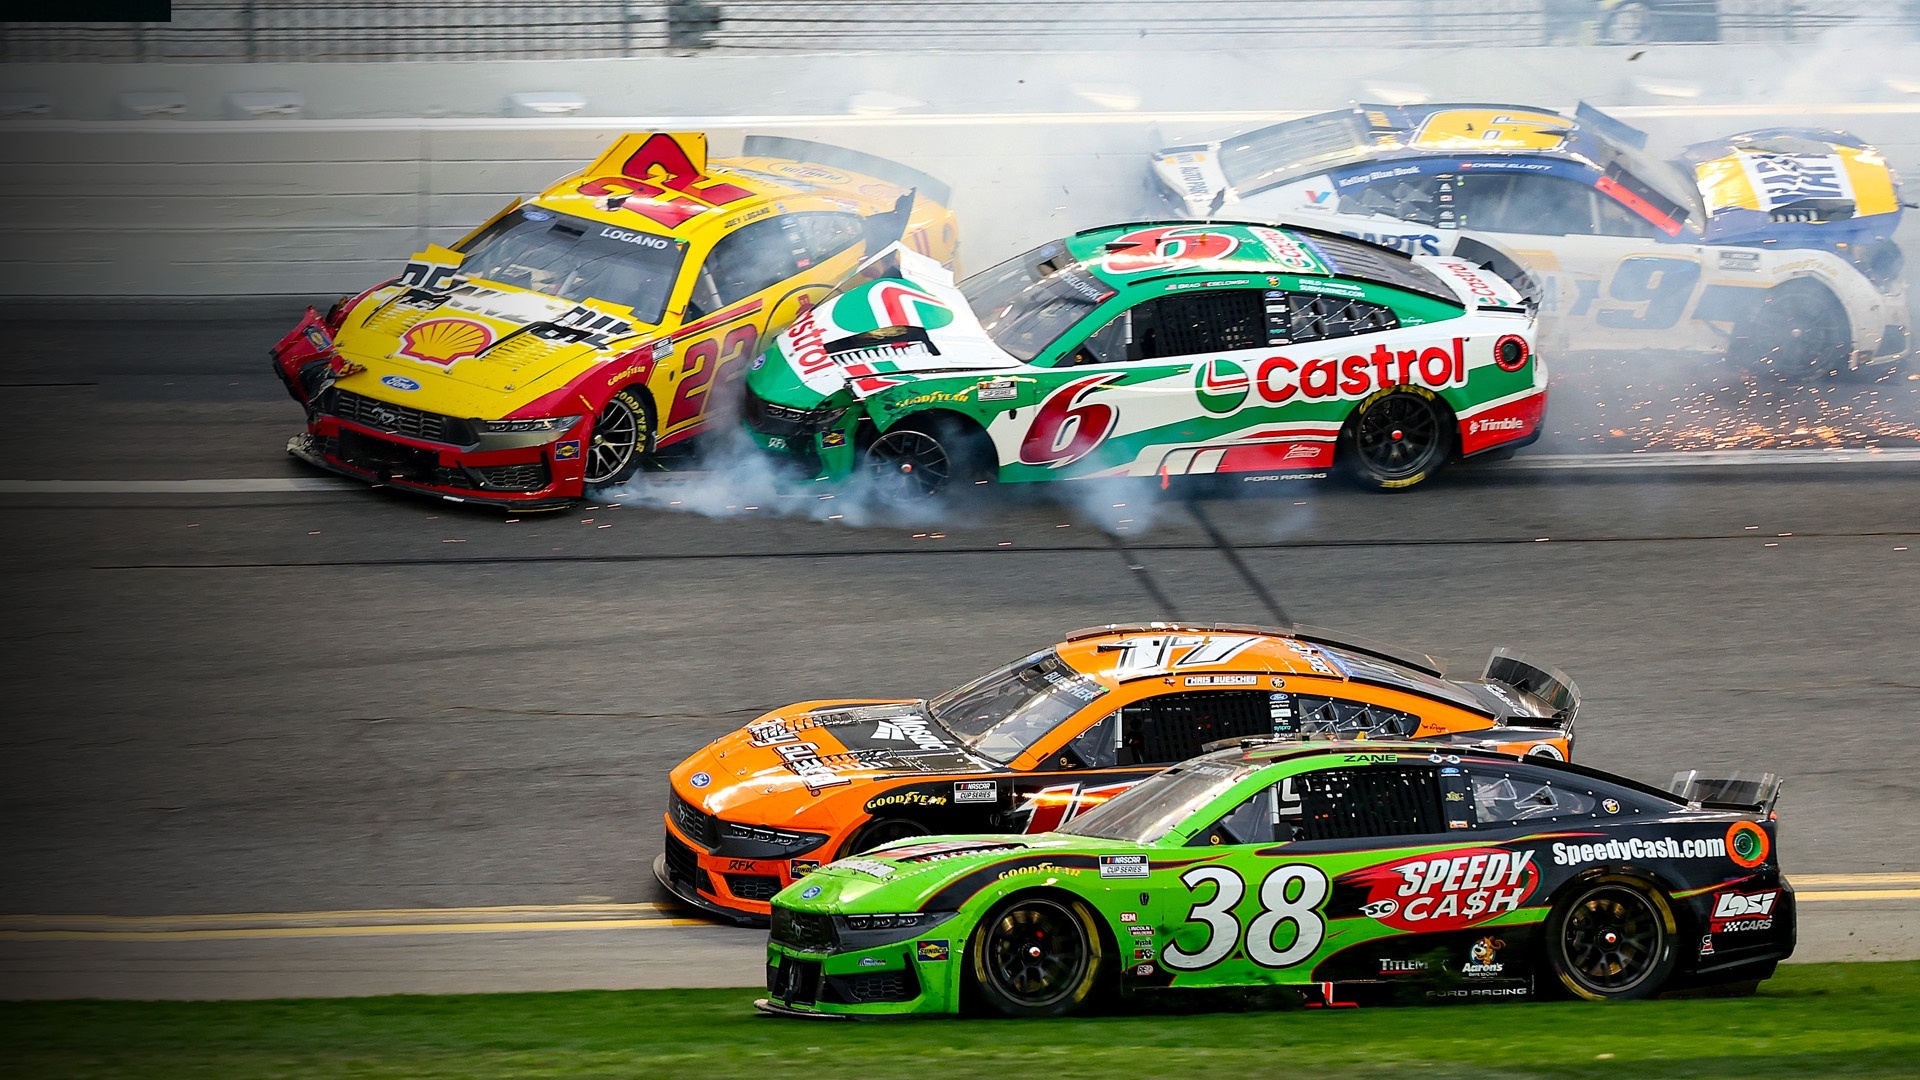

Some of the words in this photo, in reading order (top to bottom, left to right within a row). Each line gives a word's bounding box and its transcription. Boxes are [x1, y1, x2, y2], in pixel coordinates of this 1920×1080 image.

[1471, 162, 1506, 171] CHASE
[1508, 163, 1552, 171] ELLIOTT
[1338, 174, 1371, 188] Kelley
[1371, 169, 1394, 181] Blue
[1393, 165, 1421, 177] Book
[600, 227, 669, 250] LOGANO
[1177, 282, 1201, 290] BRAD
[1598, 256, 1702, 330] 9
[606, 363, 647, 387] GOODYEAR
[665, 322, 760, 430] 22
[1257, 337, 1464, 402] Castrol
[1018, 371, 1129, 470] 6
[1478, 419, 1523, 432] Trimble
[1280, 473, 1328, 481] RACING
[1344, 754, 1397, 763] ZANE
[867, 791, 947, 809] GOODYEAR
[1553, 837, 1725, 866] SpeedyCash.com
[728, 861, 755, 871] RFK
[998, 862, 1081, 880] GOODYEAR
[1390, 850, 1535, 896] SPEEDY
[1368, 904, 1393, 915] SC
[1404, 888, 1524, 922] CA$H
[1161, 863, 1329, 971] 38
[1711, 923, 1724, 932] RC
[1740, 920, 1772, 931] CARS
[1462, 963, 1503, 972] Aaron's
[1471, 988, 1527, 996] RACING
